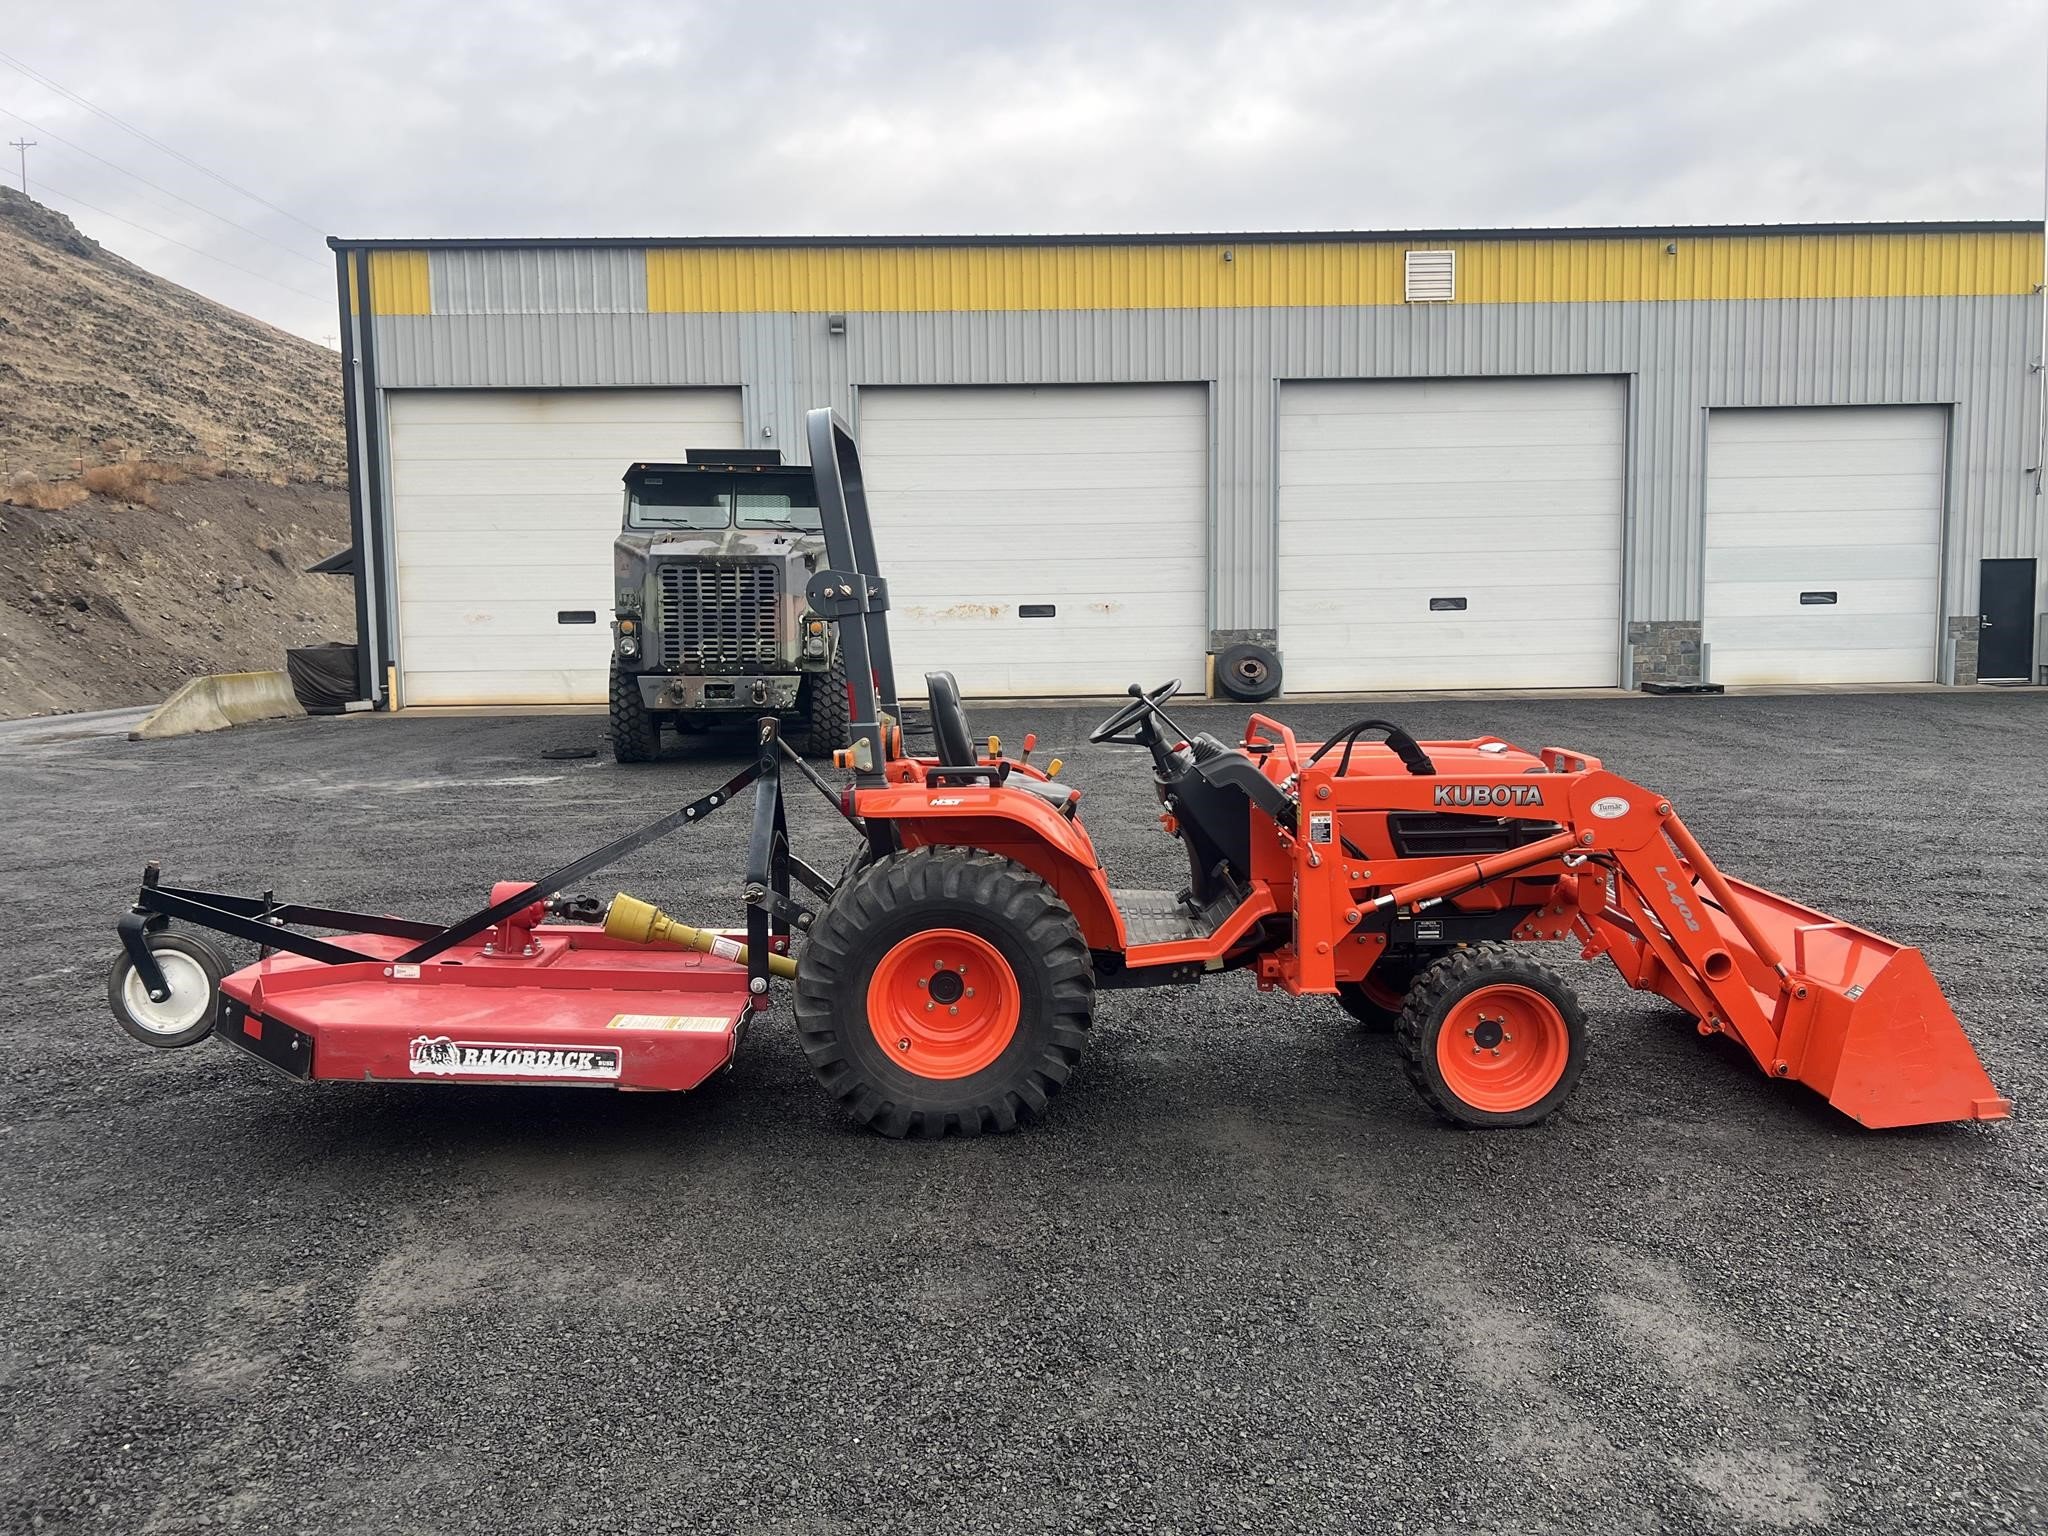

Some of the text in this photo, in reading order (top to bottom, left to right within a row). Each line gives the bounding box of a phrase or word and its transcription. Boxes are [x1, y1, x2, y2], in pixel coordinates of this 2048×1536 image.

[1433, 783, 1544, 806] KUBOTA
[1654, 865, 1701, 933] LA402
[461, 1047, 595, 1071] RAZORBACK
